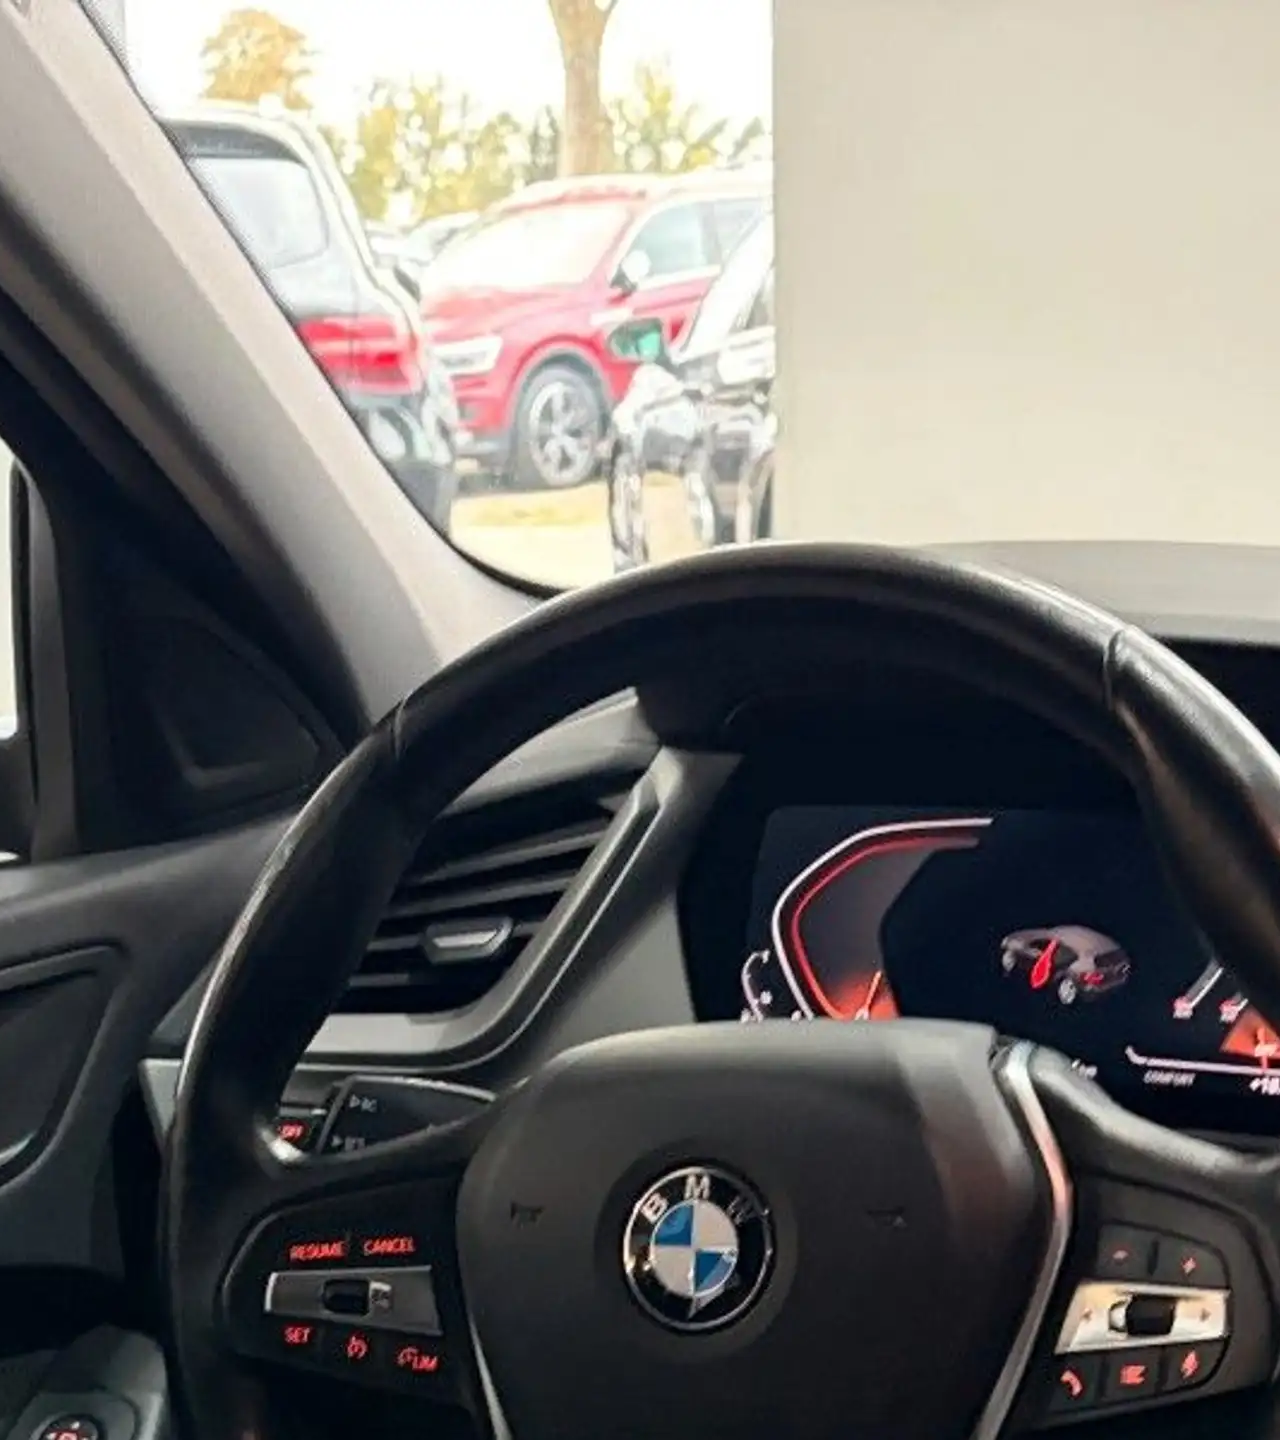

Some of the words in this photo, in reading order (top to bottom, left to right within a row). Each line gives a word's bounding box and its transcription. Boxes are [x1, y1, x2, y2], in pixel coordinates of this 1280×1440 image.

[289, 1240, 345, 1261] RESUME
[363, 1235, 415, 1256] CANCEL
[284, 1326, 311, 1344] SET
